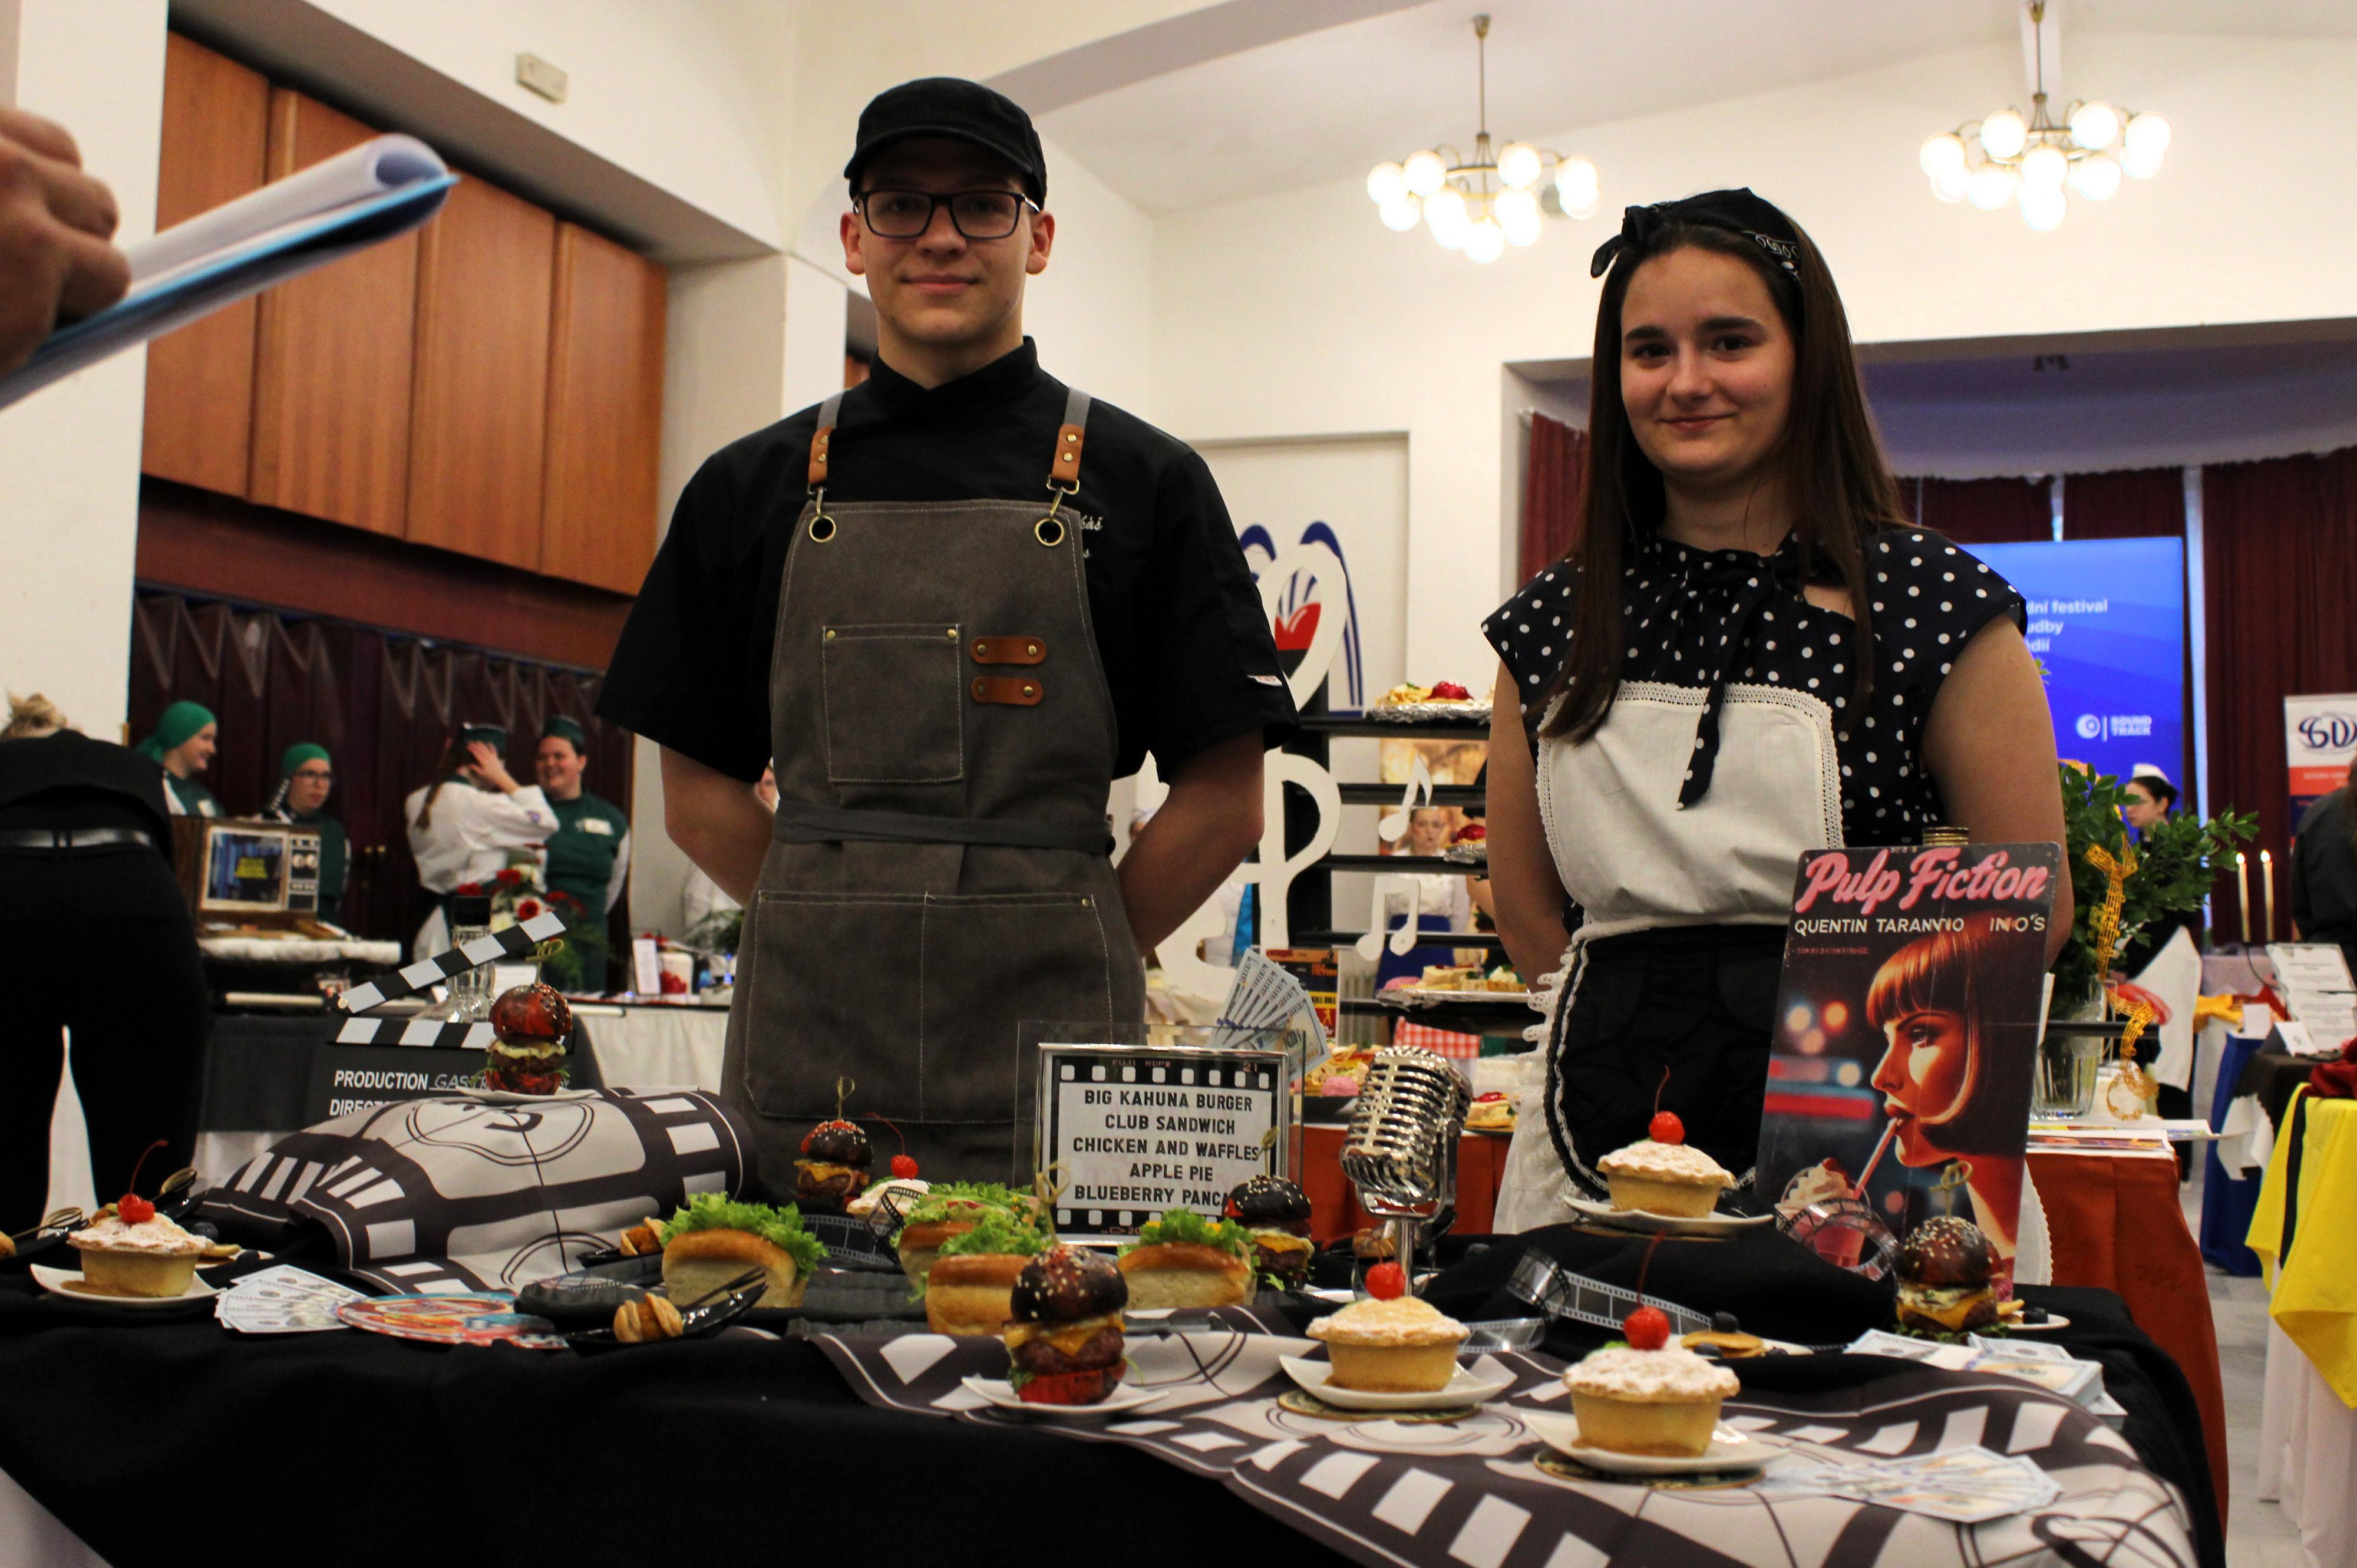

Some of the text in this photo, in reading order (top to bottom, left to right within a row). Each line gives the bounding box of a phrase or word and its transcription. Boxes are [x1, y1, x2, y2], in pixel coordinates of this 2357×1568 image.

[2052, 598, 2108, 614] festival
[1795, 847, 2048, 915] Pulp Fiction
[1794, 919, 1868, 936] QUENTIN
[334, 1070, 428, 1090] PRODUCTION
[1084, 1090, 1253, 1113] BIG KAHUNA BURGER
[1105, 1114, 1235, 1135] CLUB SANDWICH
[1073, 1137, 1259, 1161] CHICKEN AND WAFFLES
[1130, 1163, 1213, 1181] APPLE PIE
[1075, 1185, 1175, 1203] BLUEBERRY
